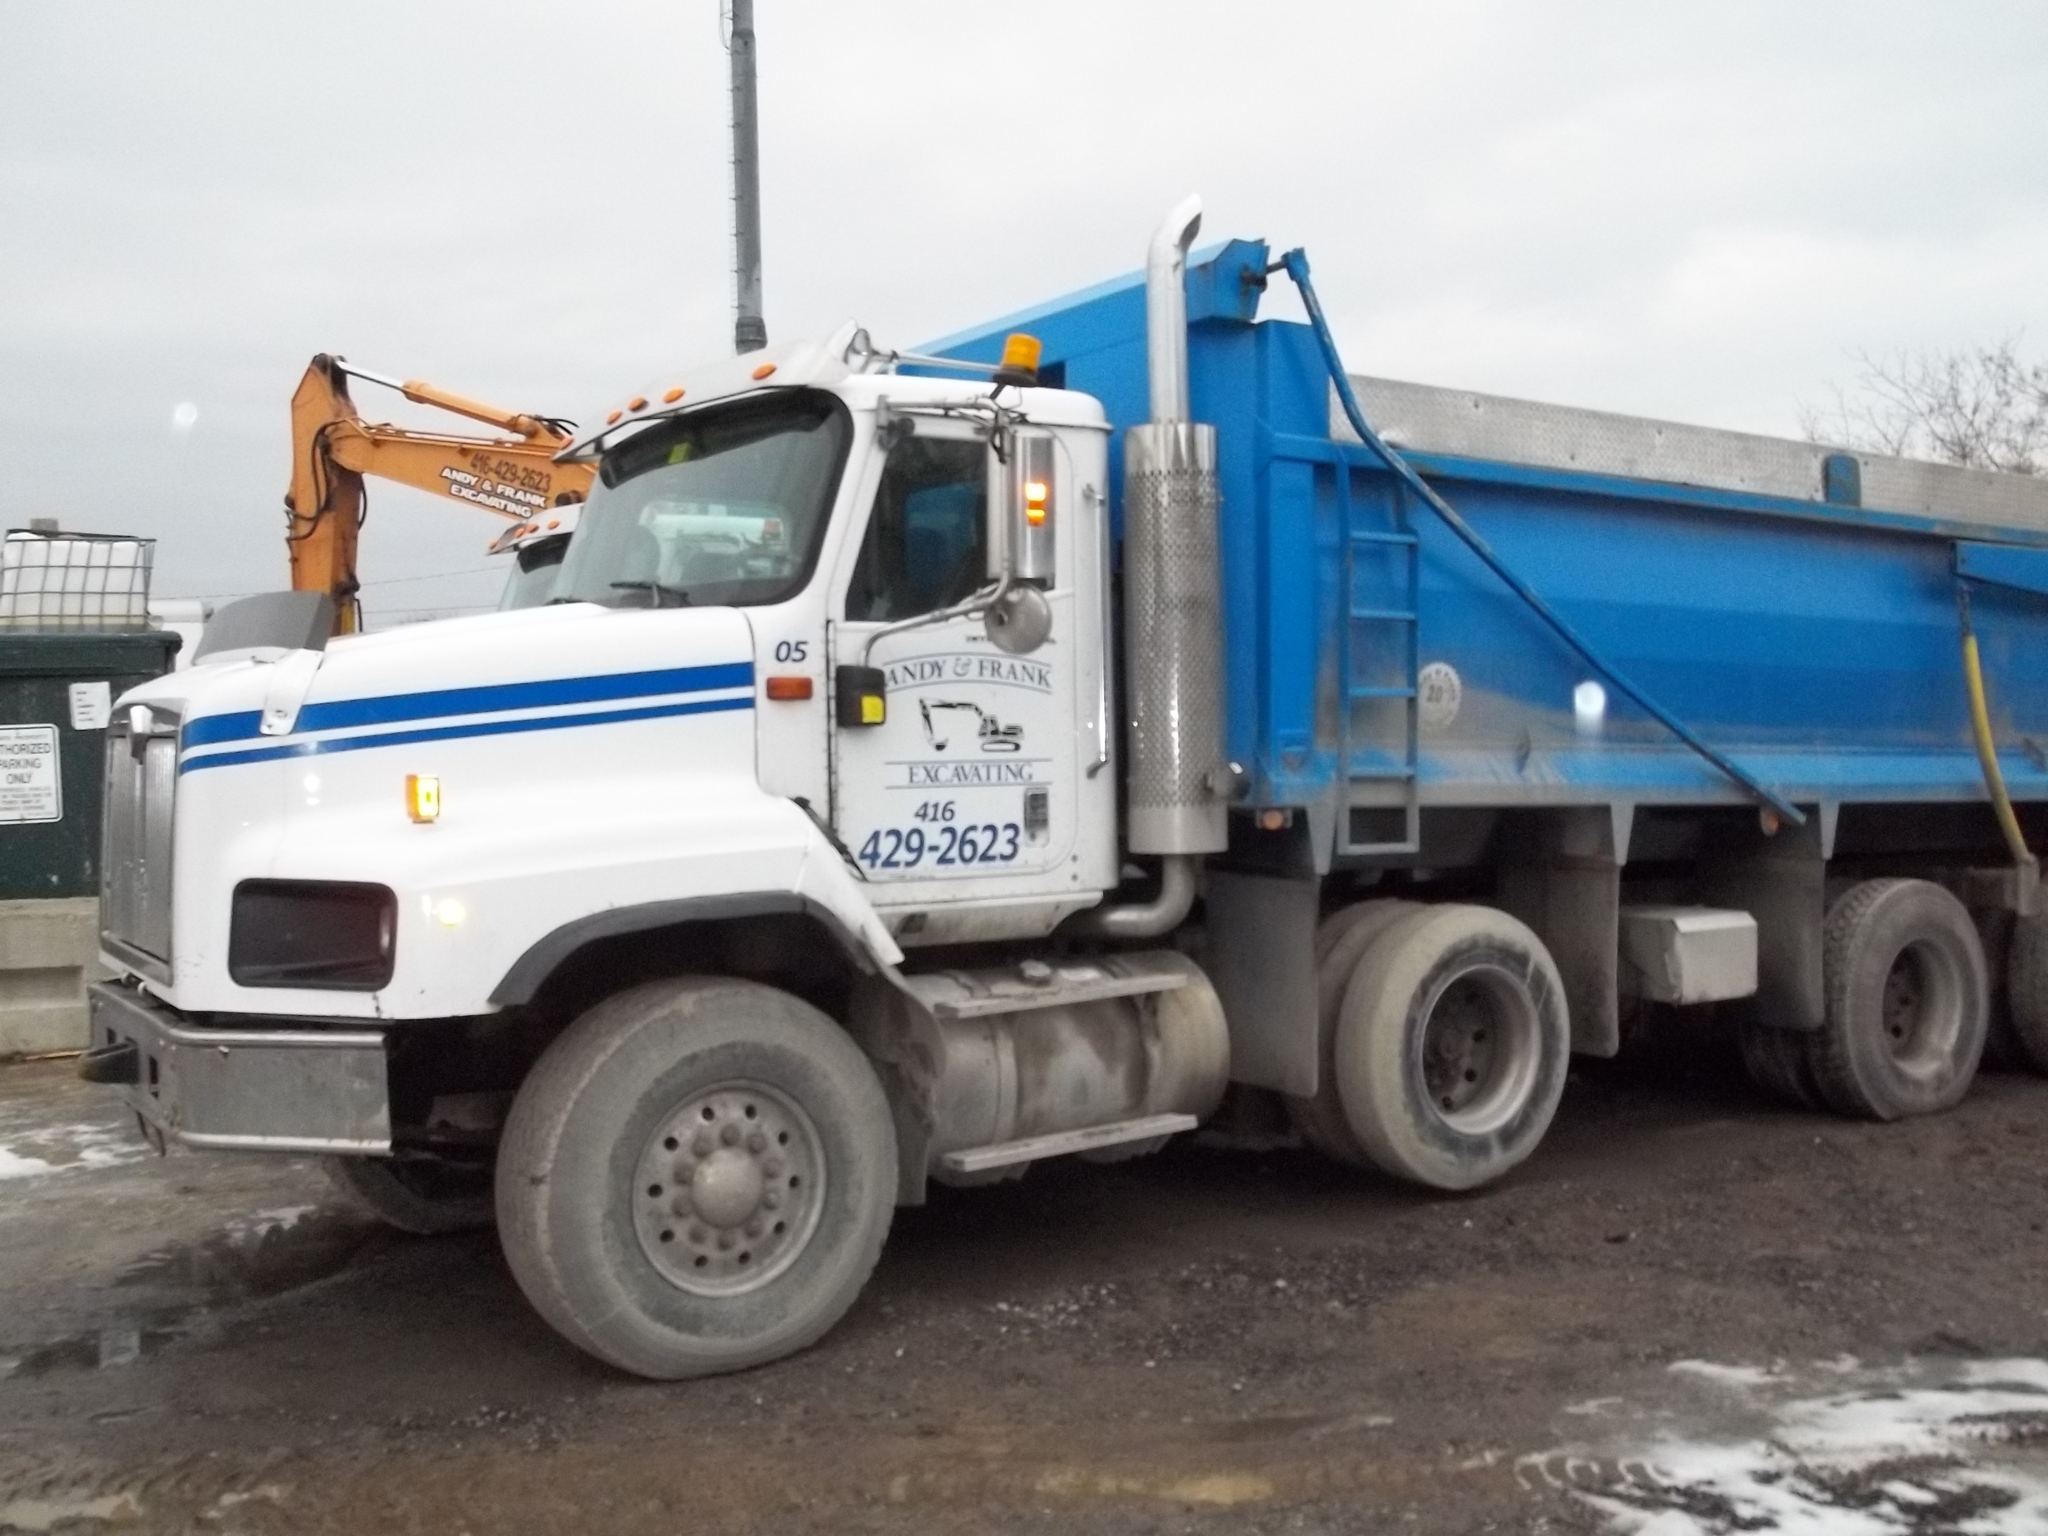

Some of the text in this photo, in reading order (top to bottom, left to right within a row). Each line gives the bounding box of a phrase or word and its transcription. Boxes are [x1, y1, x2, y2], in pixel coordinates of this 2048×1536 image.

[440, 466, 547, 509] ANDY & FRANK
[470, 452, 551, 493] 416-429-2623
[449, 483, 533, 519] EXCAVATING
[775, 640, 808, 663] 05
[886, 656, 1052, 689] ANDY & FRANK
[6, 772, 32, 785] ONLY
[908, 764, 1034, 784] EXCAVATING
[914, 801, 956, 822] 416
[858, 822, 1021, 870] 429-2623
